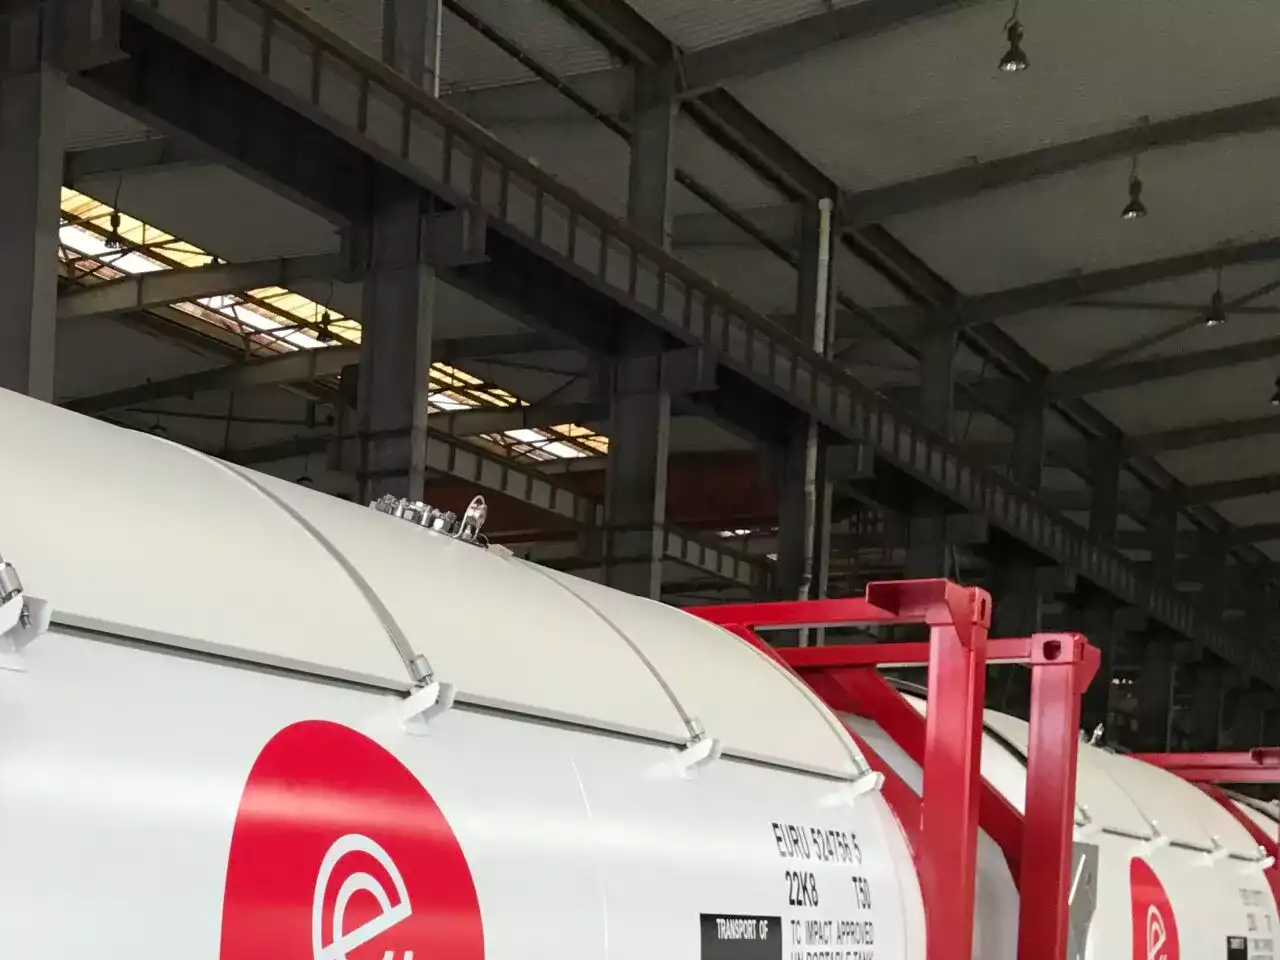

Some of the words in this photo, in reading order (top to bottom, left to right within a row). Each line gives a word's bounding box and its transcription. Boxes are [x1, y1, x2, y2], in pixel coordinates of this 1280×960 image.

[772, 822, 811, 860] EURU
[810, 827, 853, 863] 524756
[785, 870, 819, 907] 22K8
[852, 876, 871, 910] T50
[716, 918, 757, 940] TRANSPORT
[759, 919, 769, 941] OF
[790, 919, 801, 945] TC
[805, 919, 832, 946] IMPACT
[836, 920, 874, 946] APPROVED
